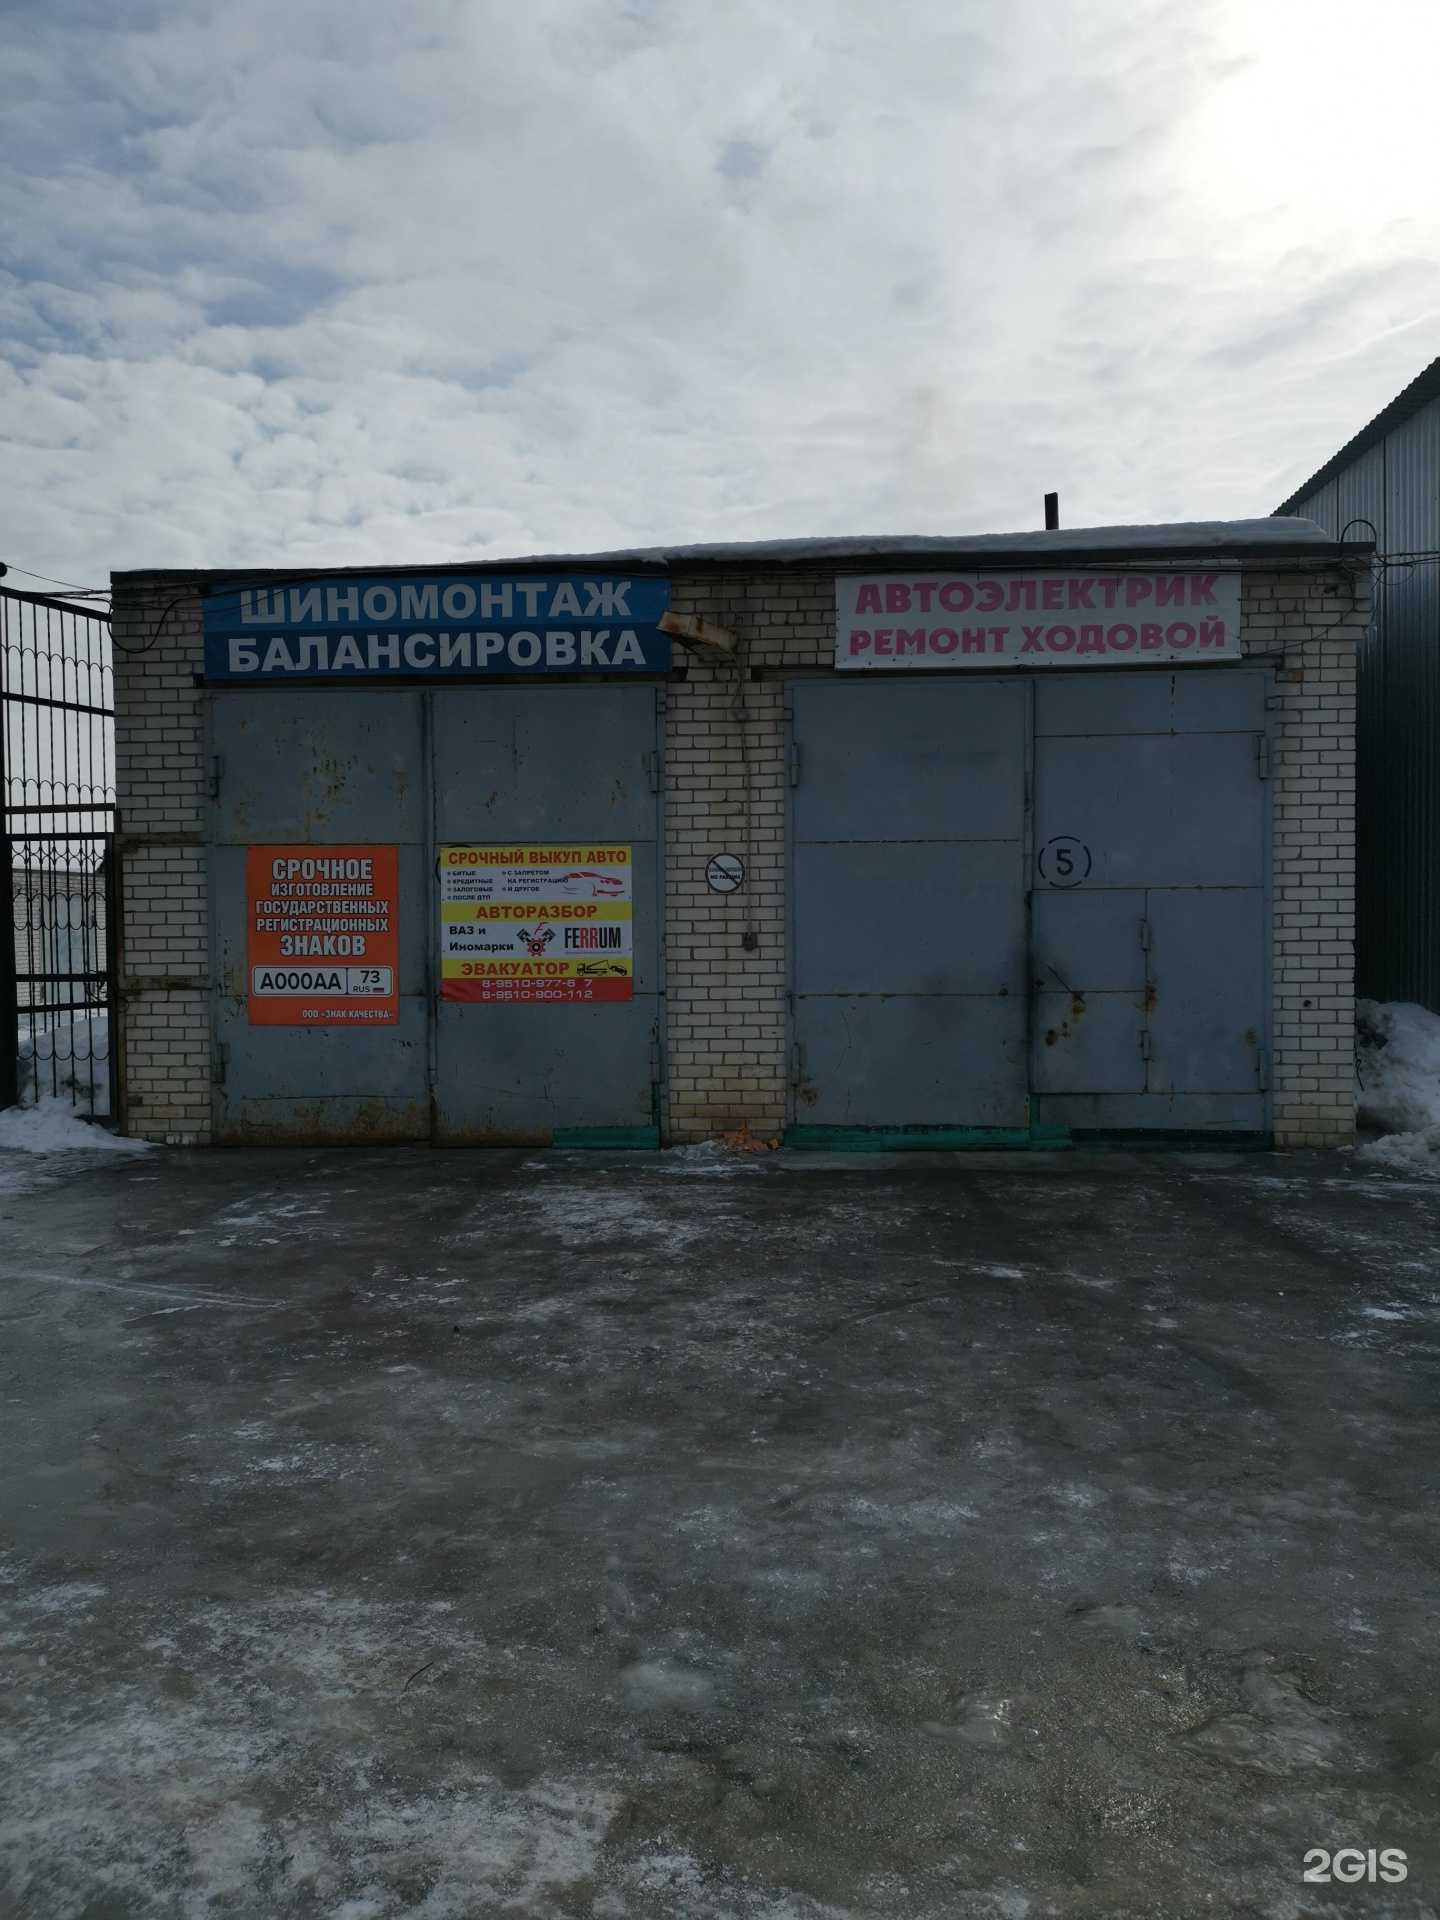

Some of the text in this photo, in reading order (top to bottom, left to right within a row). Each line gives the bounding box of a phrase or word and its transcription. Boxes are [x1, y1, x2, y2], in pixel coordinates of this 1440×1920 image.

[240, 581, 632, 624] ШИНОМОНТАЖ
[855, 575, 1220, 615] АВТОЭЛЕКТРИК
[849, 615, 1226, 656] РЕМОНТ ХОДОВОЙ
[228, 630, 647, 673] БАЛАНСИРОВКА
[448, 850, 627, 865] СРОЧНЫЙ ВЫКУП АВТО
[1056, 848, 1074, 876] 5
[272, 858, 373, 880] СРОЧНОЕ
[271, 883, 374, 896] ИЗГОТОВЛЕНИЕ
[255, 900, 389, 915] ГОСУДАРСТВЕННЫХ
[476, 905, 598, 920] АВТОРАЗБОР
[256, 918, 389, 933] РЕГИСТРАЦИОННЫХ
[449, 926, 486, 936] ВАЗ и
[280, 934, 366, 956] ЗНАКОВ
[564, 927, 621, 949] FERRUM
[449, 941, 514, 953] Иномарки
[461, 962, 569, 976] ЭВАКУАТОР
[360, 970, 381, 984] 73
[302, 1009, 319, 1018] ООО
